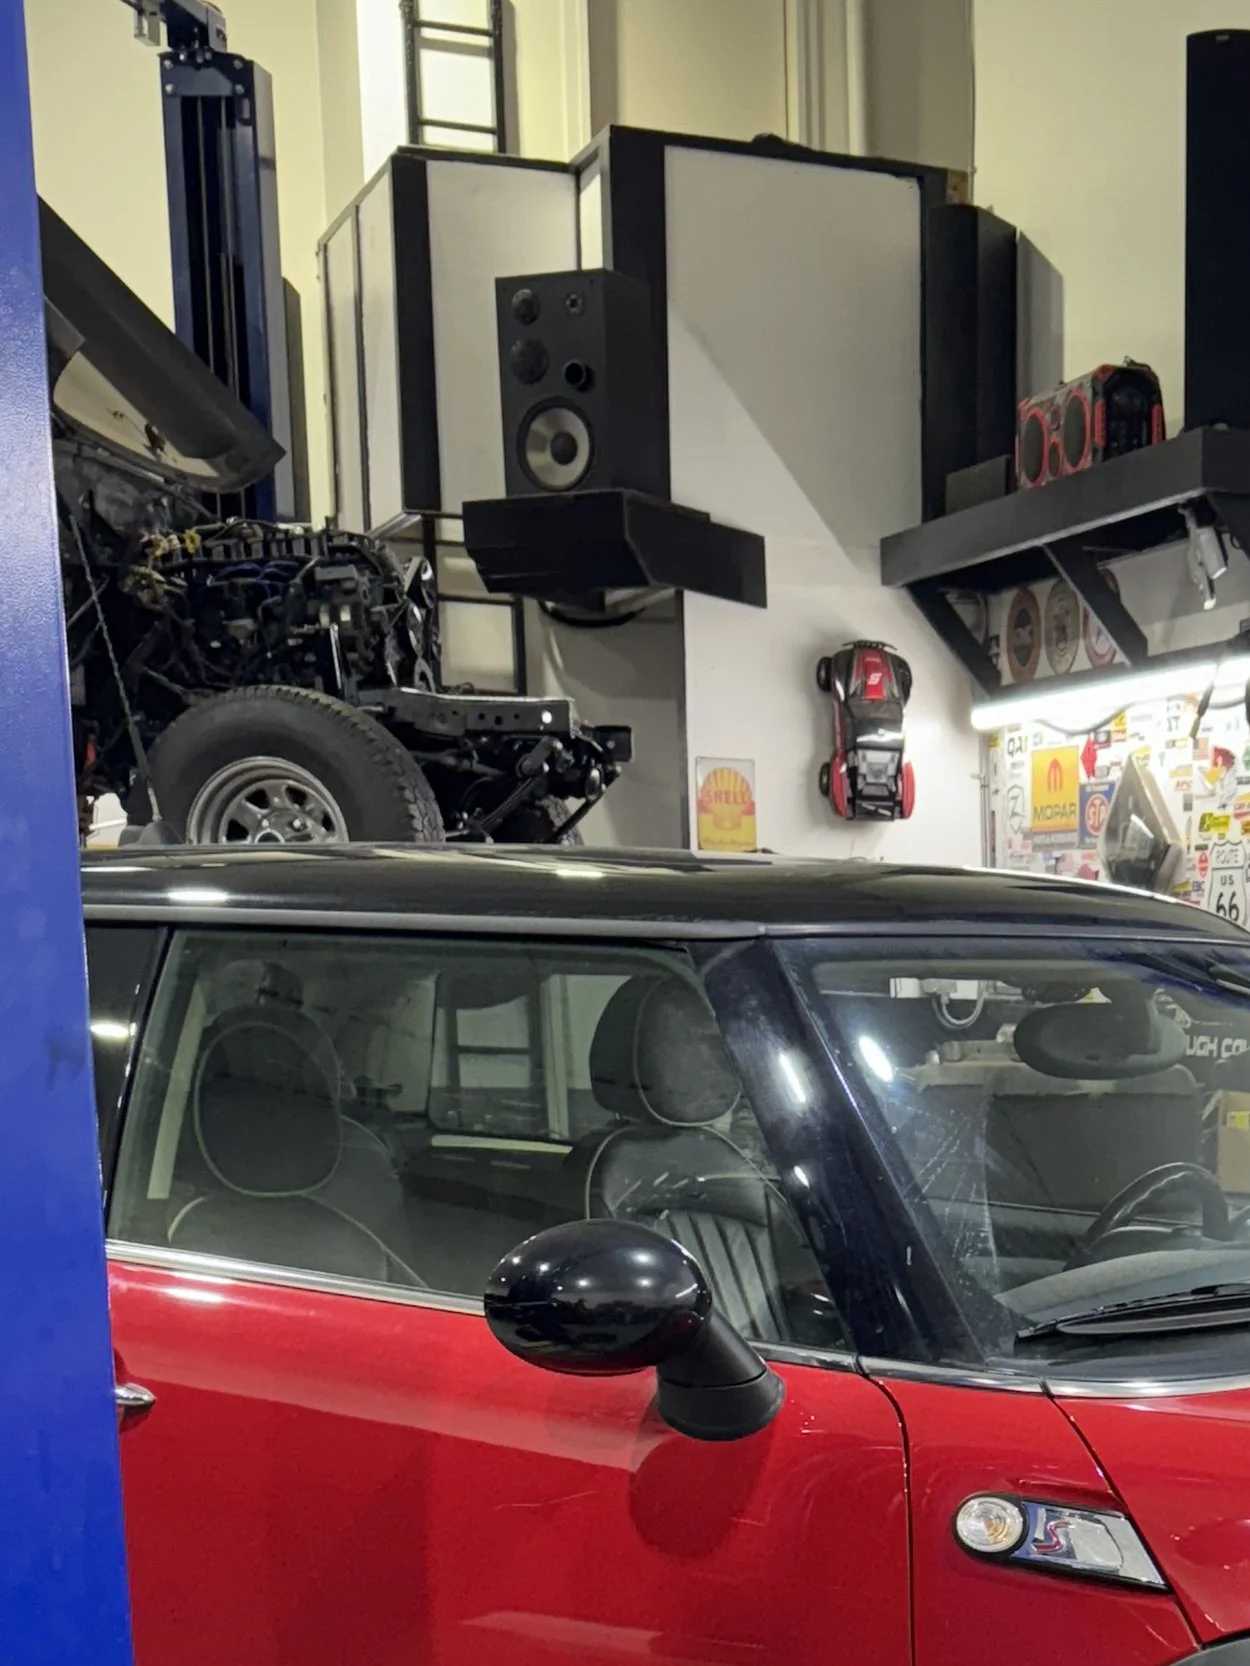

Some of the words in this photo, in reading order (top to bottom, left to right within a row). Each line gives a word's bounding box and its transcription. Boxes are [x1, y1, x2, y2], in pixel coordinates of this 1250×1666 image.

[706, 789, 752, 806] SHELL
[1033, 803, 1077, 821] MOPAR
[1216, 848, 1240, 865] ROUTE
[1220, 874, 1235, 886] US
[1215, 891, 1240, 922] 66
